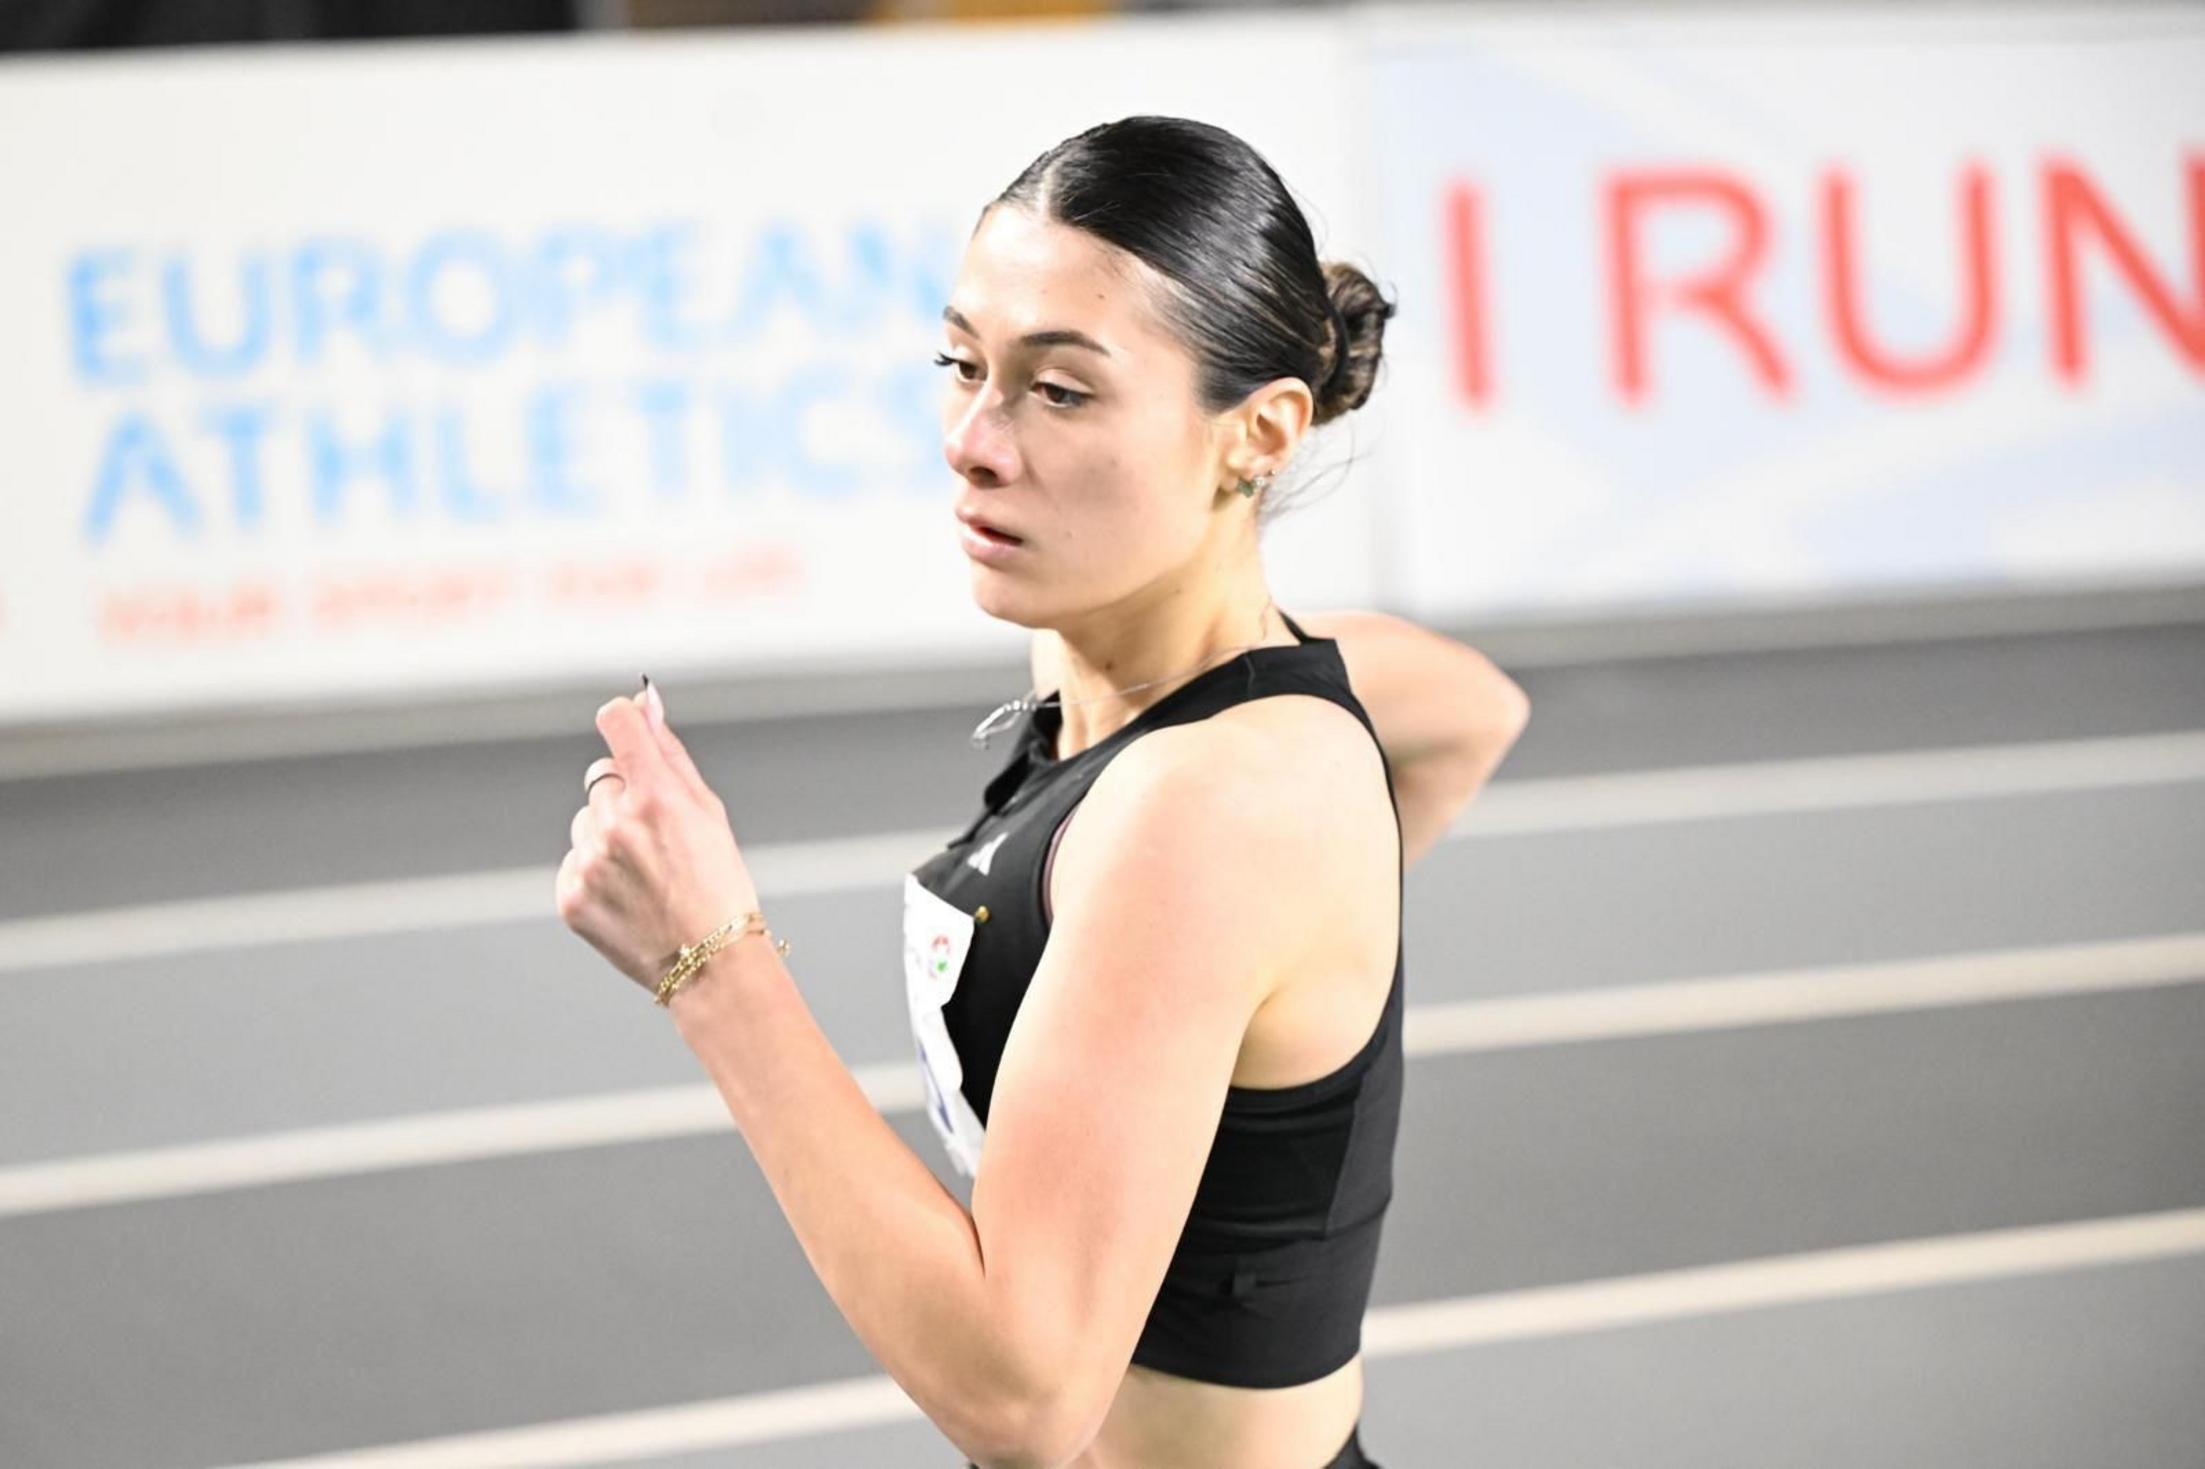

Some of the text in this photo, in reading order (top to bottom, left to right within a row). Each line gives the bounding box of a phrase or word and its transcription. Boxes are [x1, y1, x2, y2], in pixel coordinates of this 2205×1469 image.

[66, 224, 956, 386] EUROPEAN
[1443, 146, 2205, 410] I RUN
